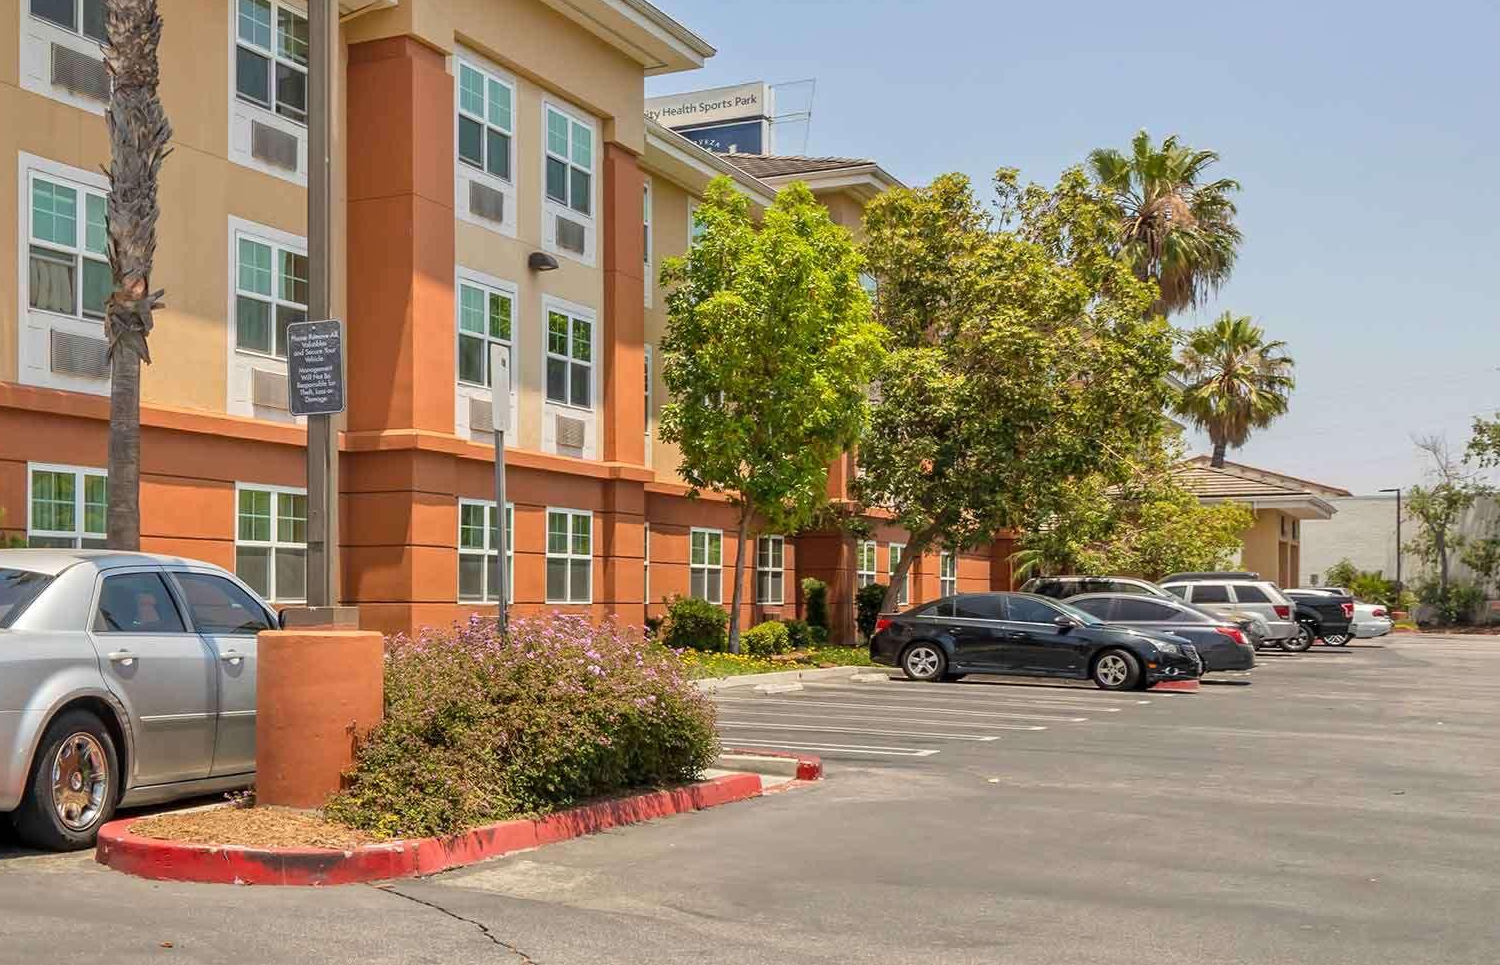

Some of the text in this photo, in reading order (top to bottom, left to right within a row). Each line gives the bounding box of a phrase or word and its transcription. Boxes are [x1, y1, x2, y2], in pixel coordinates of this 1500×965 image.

[662, 102, 697, 117] Health
[699, 100, 732, 113] Sports
[735, 93, 757, 106] Park
